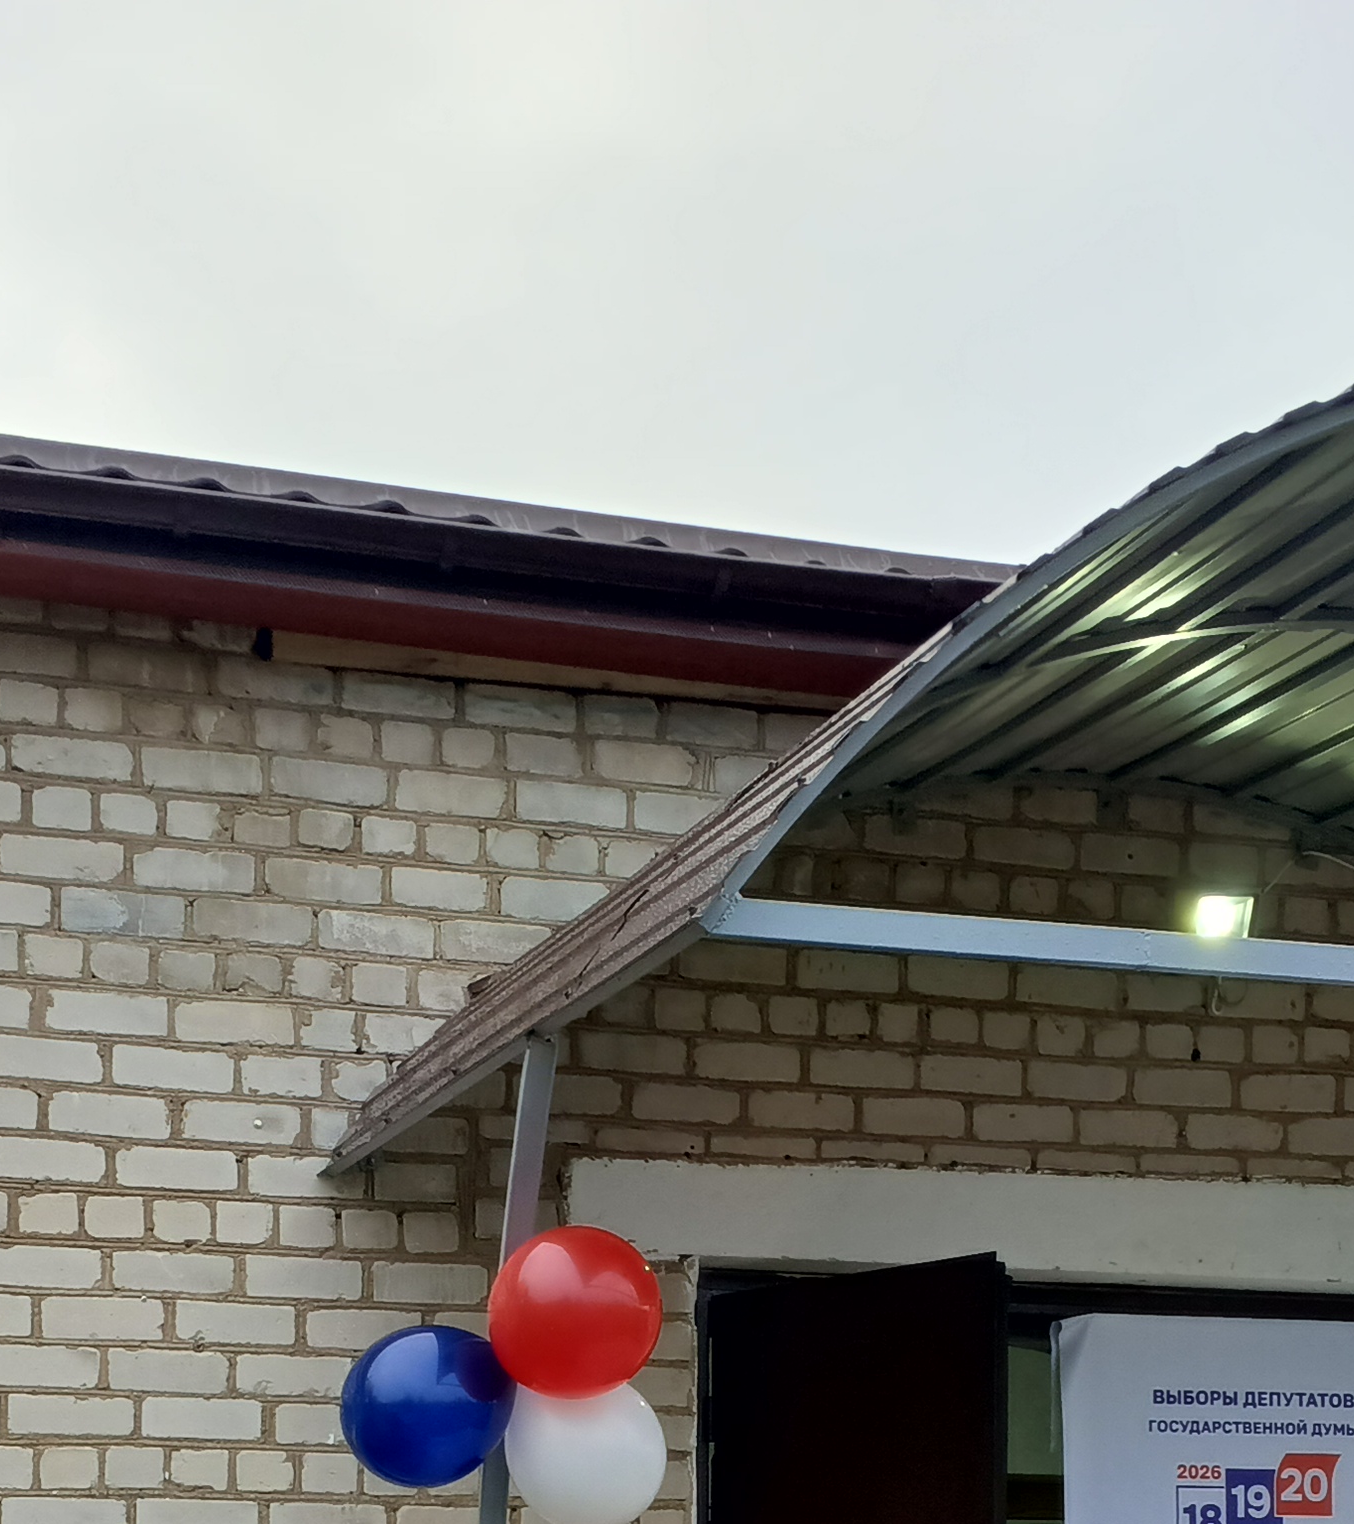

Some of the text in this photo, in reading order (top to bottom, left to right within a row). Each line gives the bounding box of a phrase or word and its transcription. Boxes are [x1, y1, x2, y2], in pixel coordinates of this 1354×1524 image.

[1152, 1388, 1354, 1409] ВЫБОРЫ ДЕПУТАТОВ
[1148, 1419, 1308, 1435] ГОСУДАРСТВЕННОЙ
[1177, 1464, 1222, 1480] 2026
[1231, 1484, 1271, 1519] 19
[1280, 1468, 1328, 1502] 20
